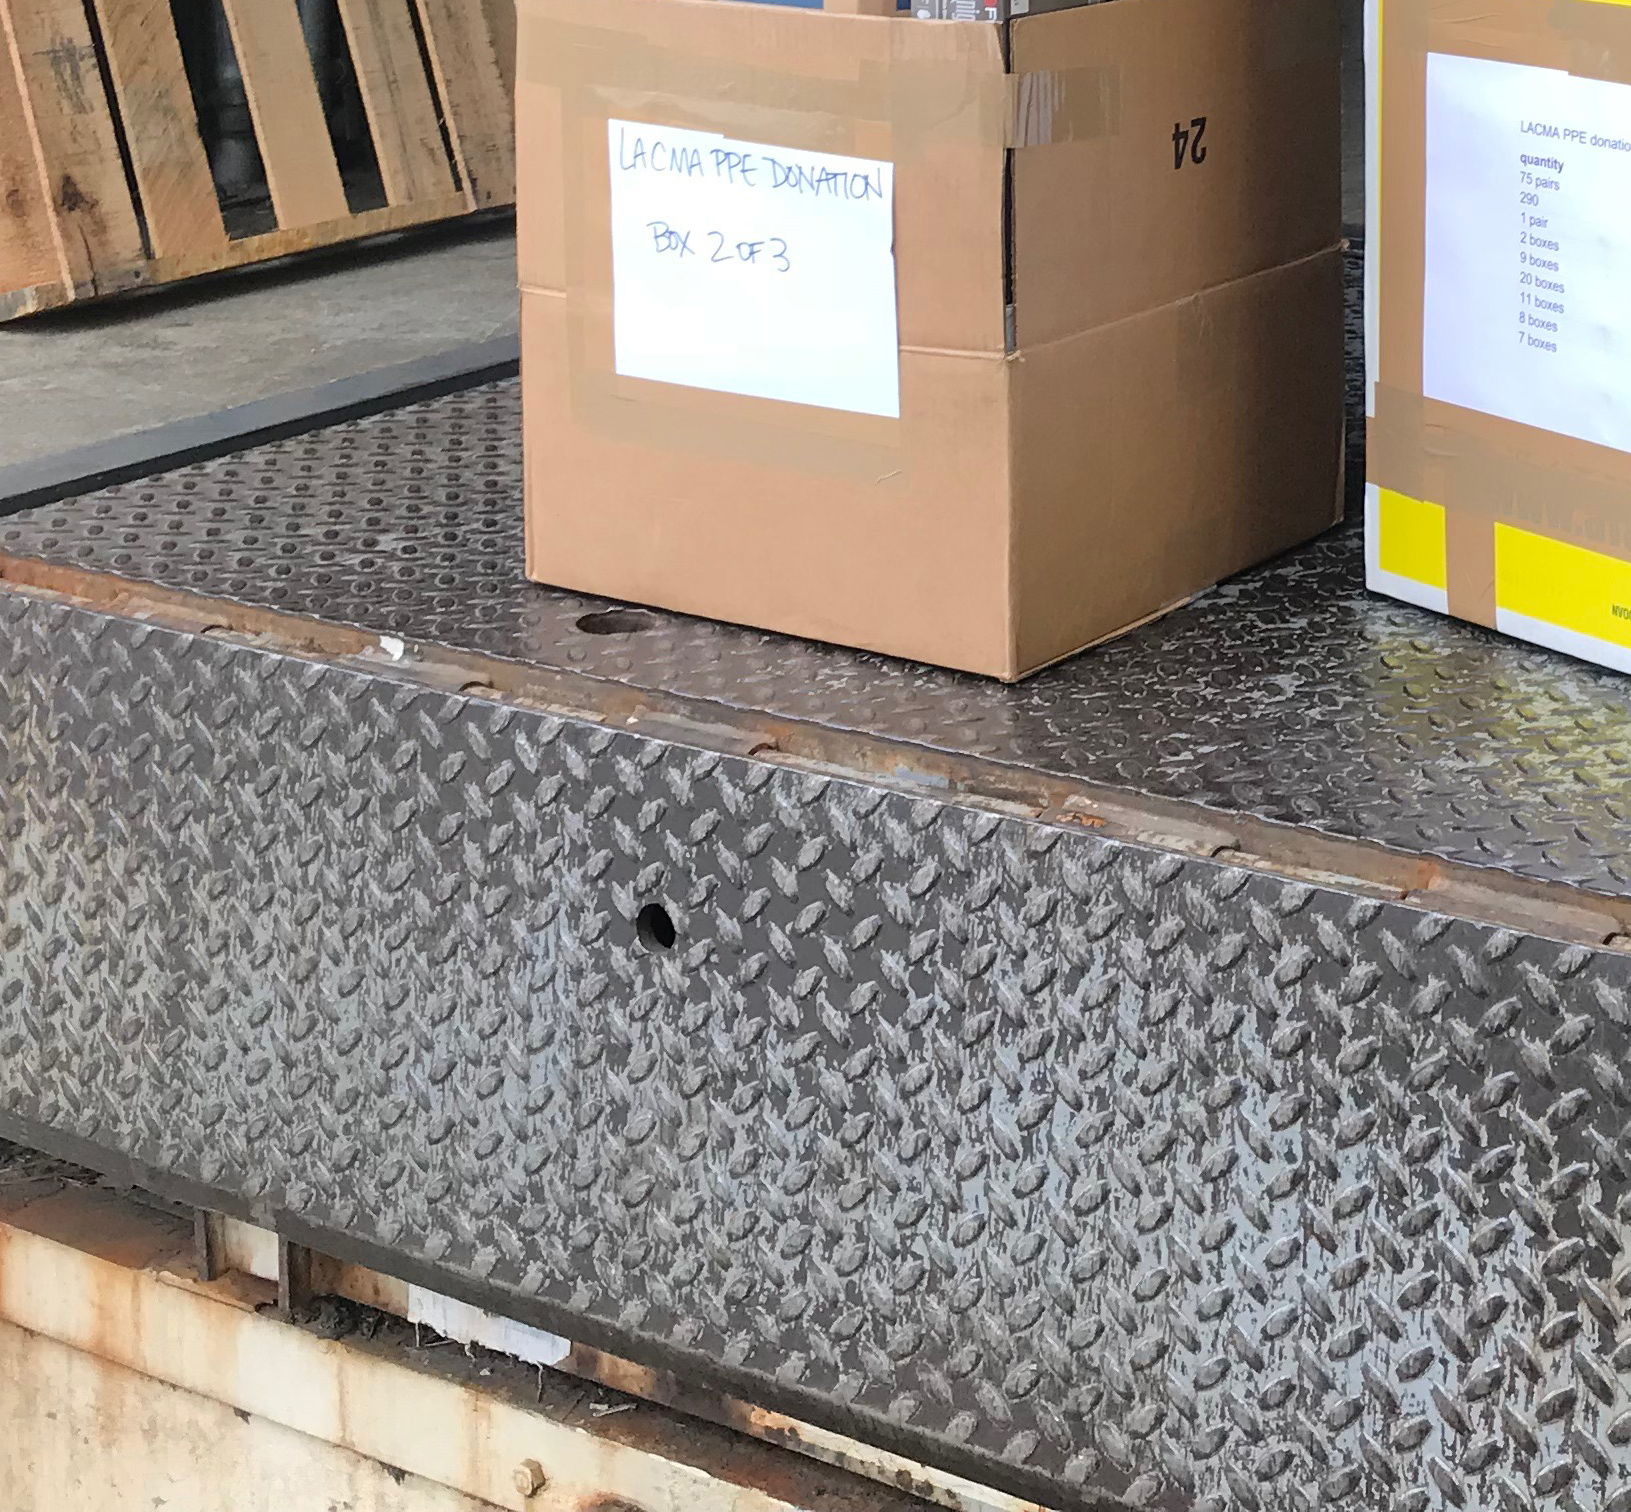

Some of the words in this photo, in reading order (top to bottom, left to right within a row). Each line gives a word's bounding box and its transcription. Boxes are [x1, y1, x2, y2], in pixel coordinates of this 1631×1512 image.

[1171, 116, 1207, 170] 24
[1520, 120, 1560, 140] LACMA
[1563, 127, 1587, 144] PPE
[619, 127, 704, 177] LACMA
[709, 148, 759, 187] PPE
[761, 156, 883, 201] DONATION
[1520, 152, 1564, 174] quantity
[1520, 171, 1533, 185] 75
[1535, 174, 1560, 191] pairs
[1520, 191, 1539, 207] 290
[1529, 215, 1548, 230] pair
[707, 231, 735, 263] 2
[735, 241, 766, 264] OF
[770, 237, 791, 273] 3
[1520, 231, 1527, 244] 2
[1529, 233, 1560, 252] boxes
[1520, 251, 1527, 264] 9
[1529, 253, 1560, 272] boxes
[1520, 271, 1533, 285] 20
[1535, 274, 1565, 294] boxes
[1520, 291, 1531, 305] 11
[1535, 295, 1565, 315] boxes
[1519, 311, 1526, 324] 8
[1528, 313, 1558, 333] boxes
[1518, 331, 1525, 344] 7
[1527, 334, 1558, 354] boxes
